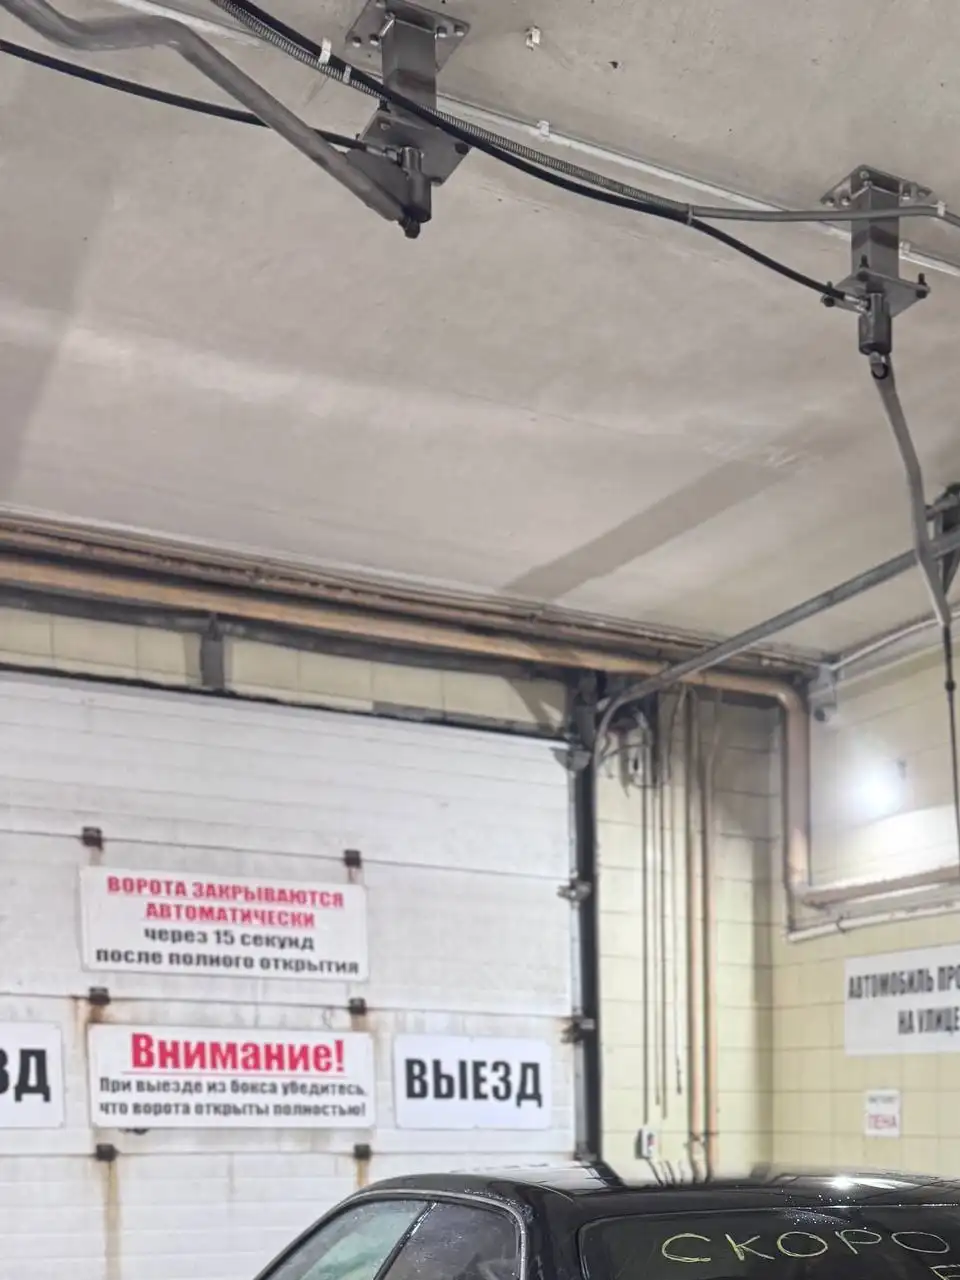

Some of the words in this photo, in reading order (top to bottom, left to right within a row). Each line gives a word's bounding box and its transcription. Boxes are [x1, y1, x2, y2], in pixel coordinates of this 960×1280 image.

[107, 876, 187, 898] ВОРОТА
[192, 881, 345, 908] ЗАКРЫВАЮТСЯ
[146, 902, 315, 928] АВТОМАТИЧЕСКИ
[144, 928, 208, 945] через
[215, 929, 235, 946] 15
[240, 933, 315, 952] секунд
[96, 949, 163, 965] после
[168, 953, 253, 970] полного
[259, 956, 360, 975] открытия
[848, 968, 934, 999] АВТОМОБИЛЬ
[898, 1010, 914, 1034] НА
[918, 1007, 960, 1036] УЛИЦЕ
[131, 1032, 344, 1073] Внимание!
[99, 1077, 132, 1095] При
[136, 1079, 202, 1095] выезде
[207, 1082, 226, 1094] из
[230, 1079, 277, 1095] бокса
[405, 1058, 543, 1109] ВЫЕЗД
[99, 1101, 128, 1116] что
[132, 1102, 191, 1117] ворота
[195, 1102, 269, 1118] открыты
[273, 1102, 366, 1117] полностью!
[662, 1229, 949, 1263] СКОРО
